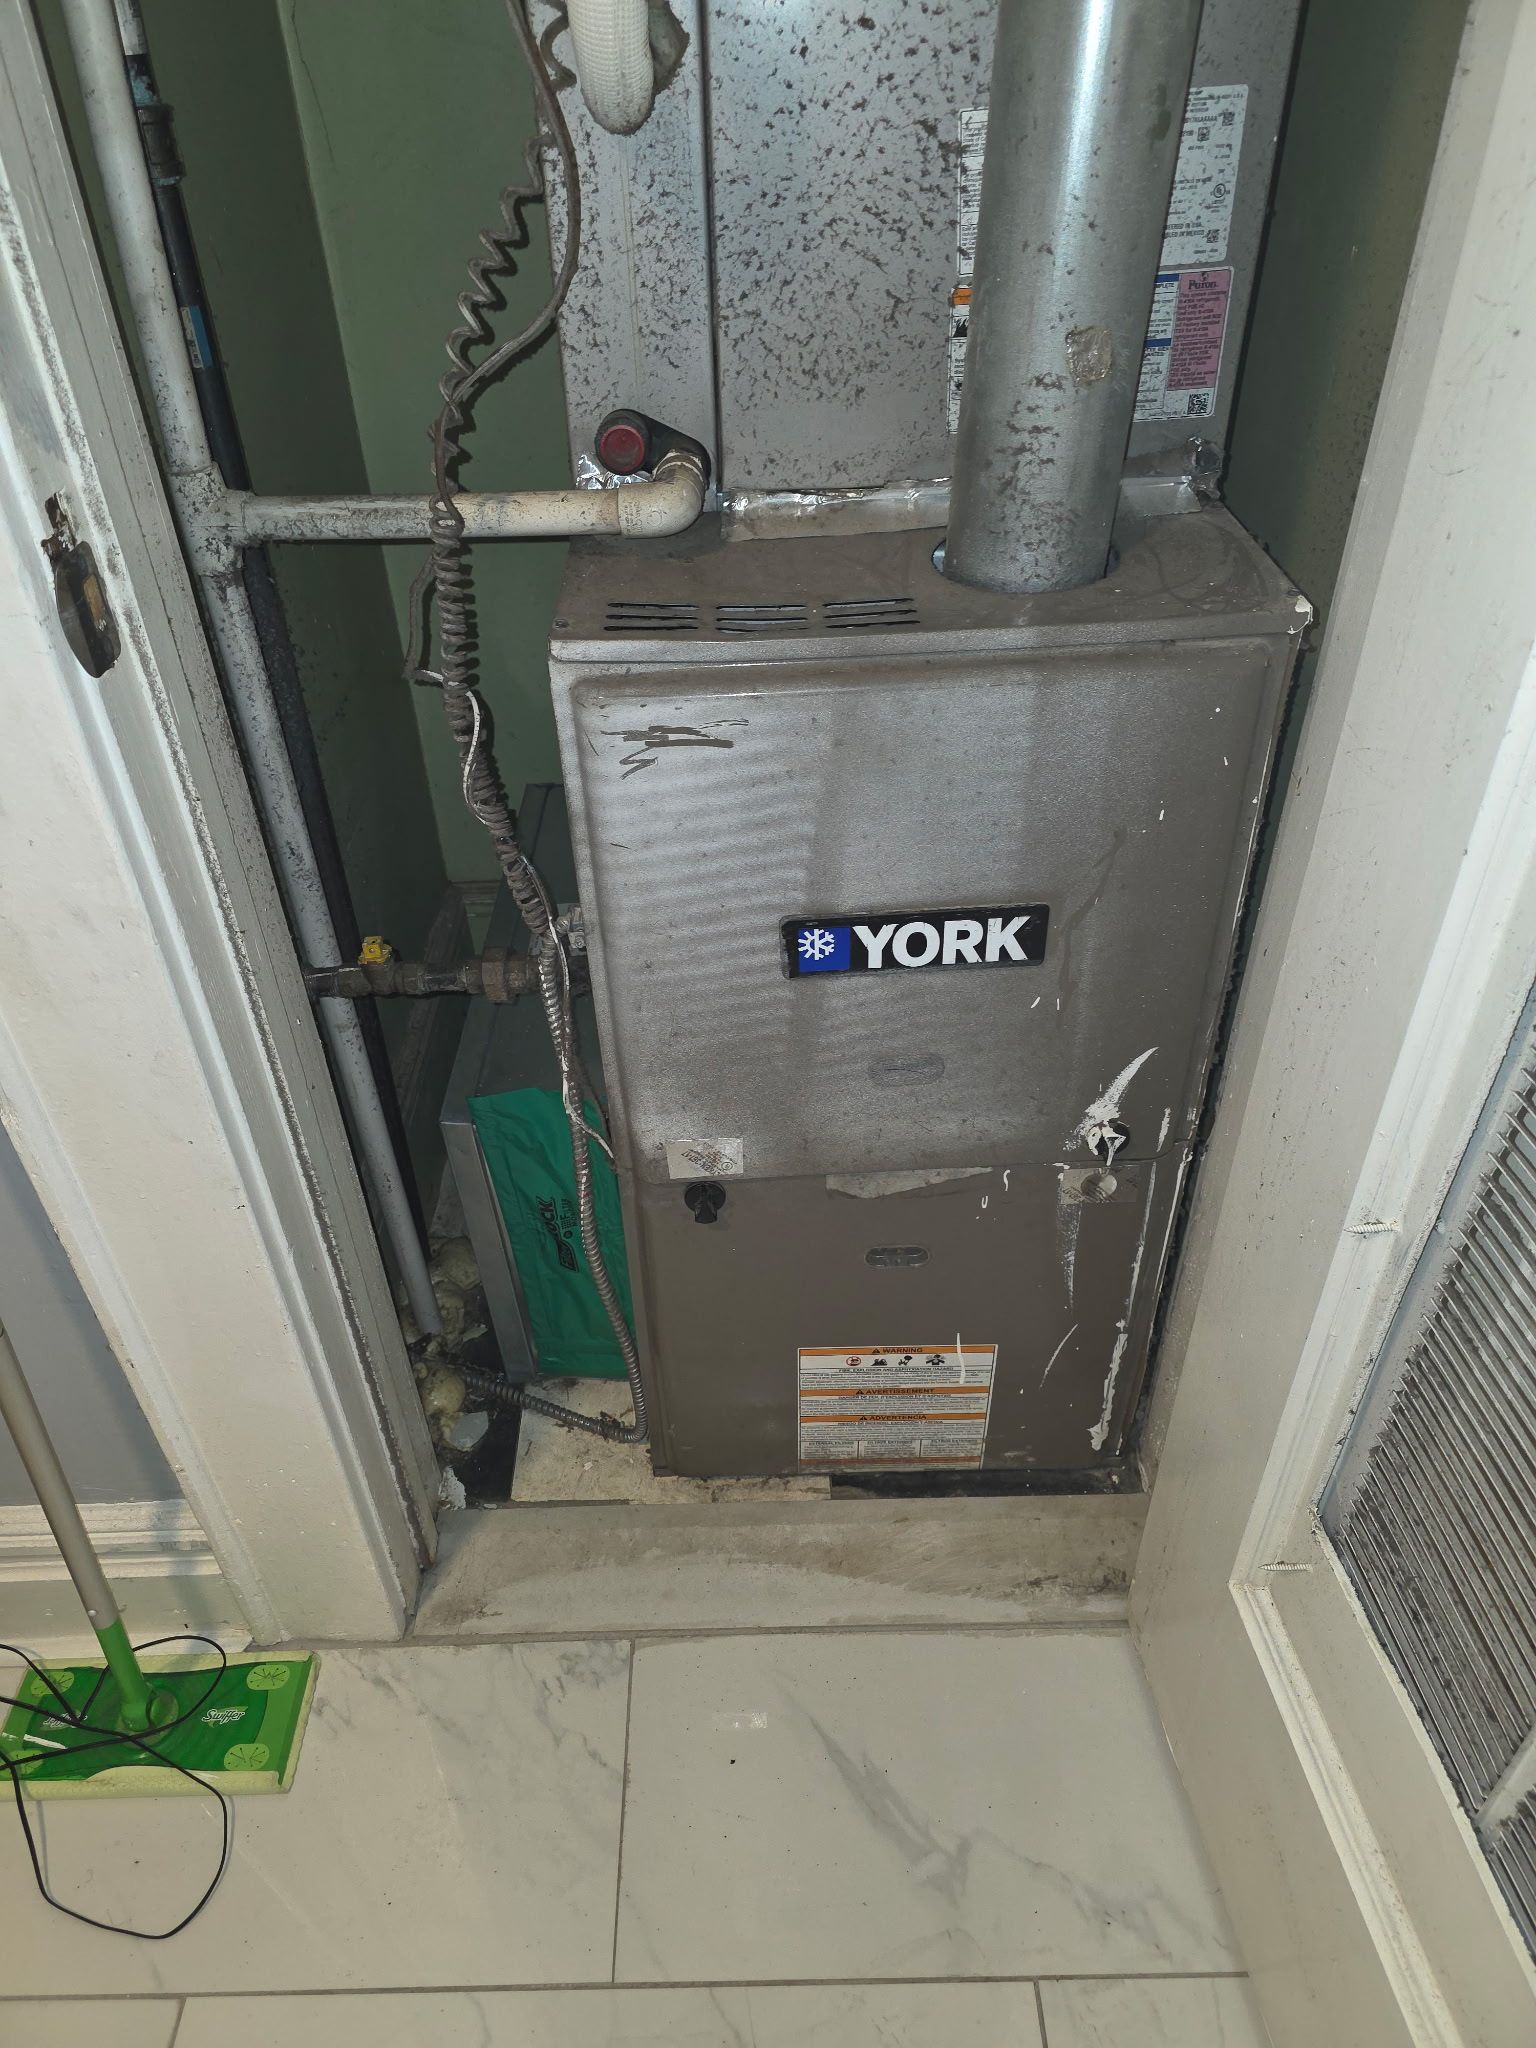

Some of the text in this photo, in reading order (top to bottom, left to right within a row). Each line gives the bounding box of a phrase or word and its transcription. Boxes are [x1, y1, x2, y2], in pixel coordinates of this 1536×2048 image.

[1188, 280, 1217, 290] Puron
[852, 916, 1031, 969] YORK
[202, 1708, 245, 1724] Swiffer
